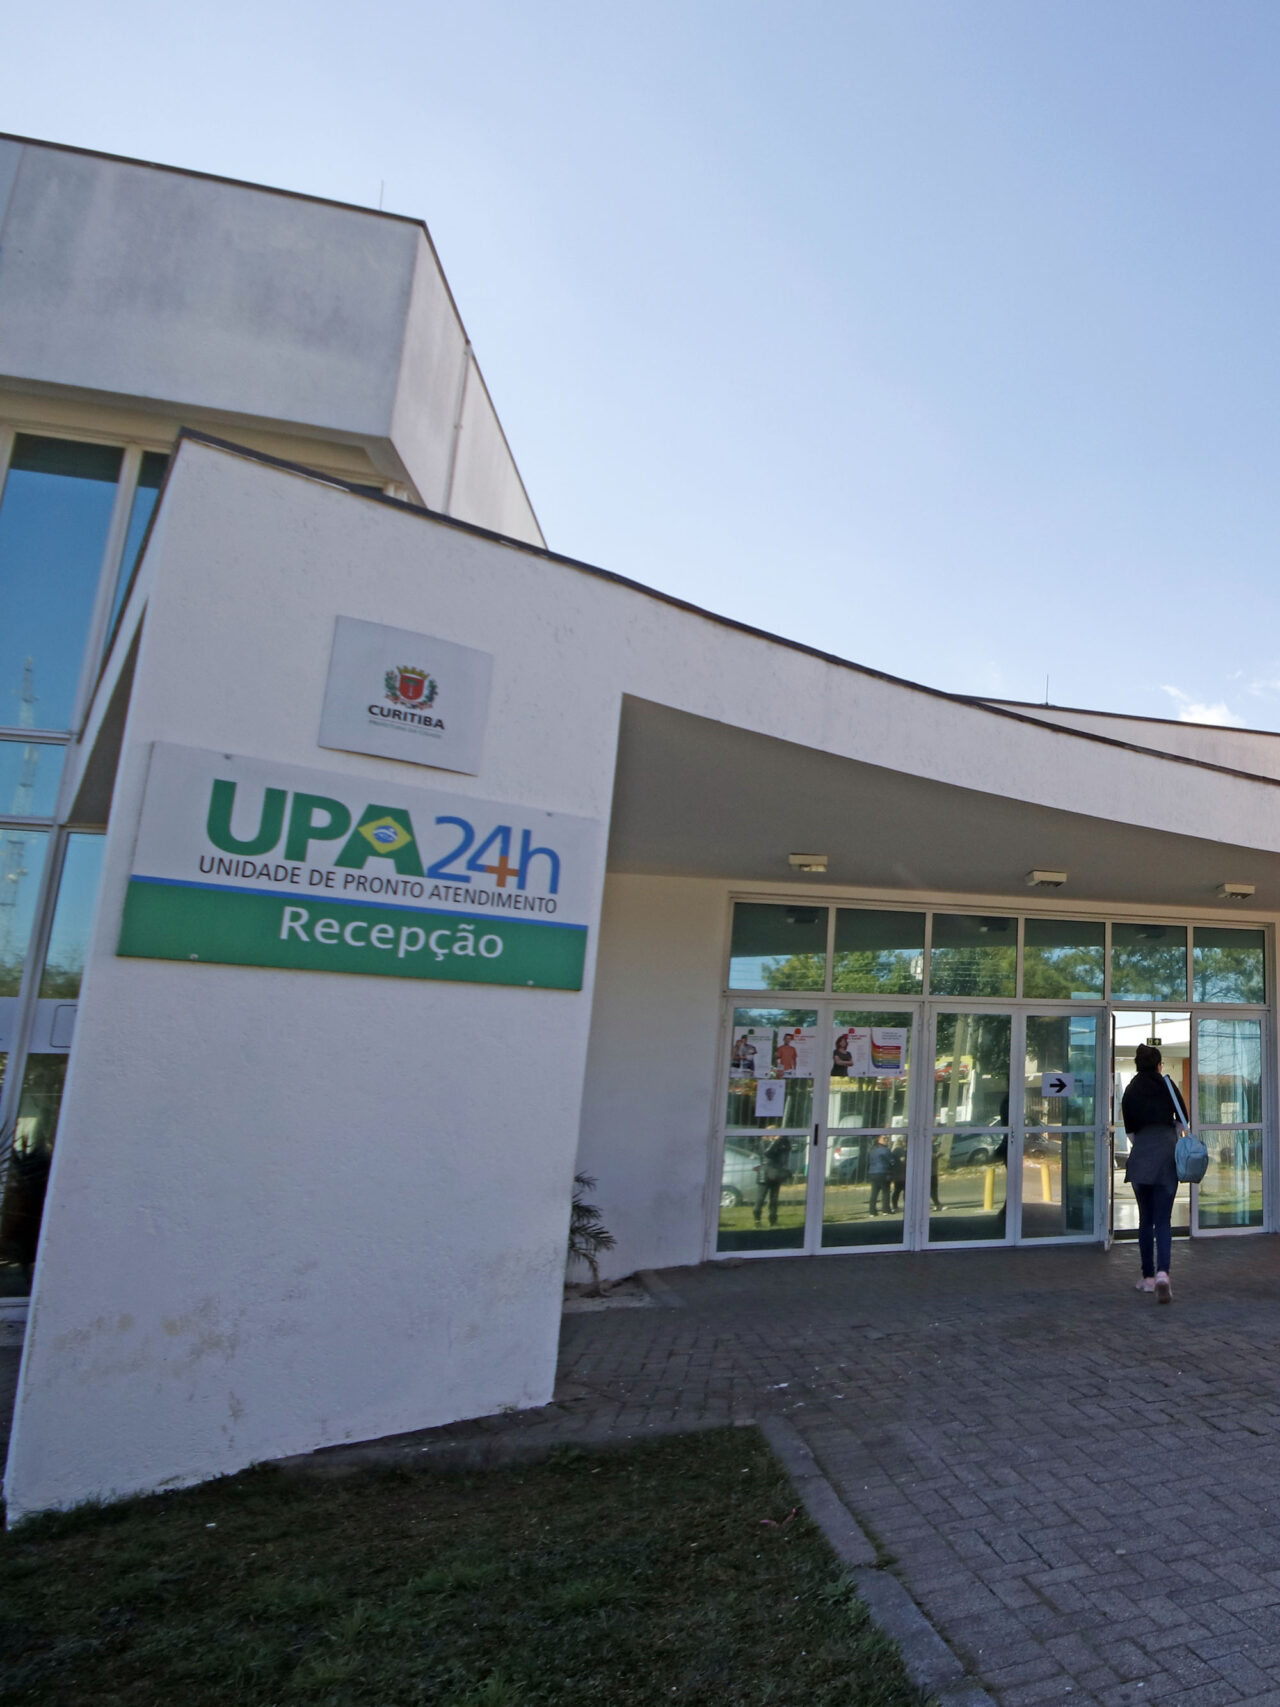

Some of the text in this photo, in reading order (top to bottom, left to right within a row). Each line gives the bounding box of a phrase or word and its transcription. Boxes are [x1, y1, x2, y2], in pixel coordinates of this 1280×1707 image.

[368, 704, 445, 730] CURITIBA
[206, 778, 560, 895] UPA 24h
[199, 855, 558, 914] UNIDADE DE PRONTO ATENDIMENTO
[279, 905, 504, 961] Recepção
